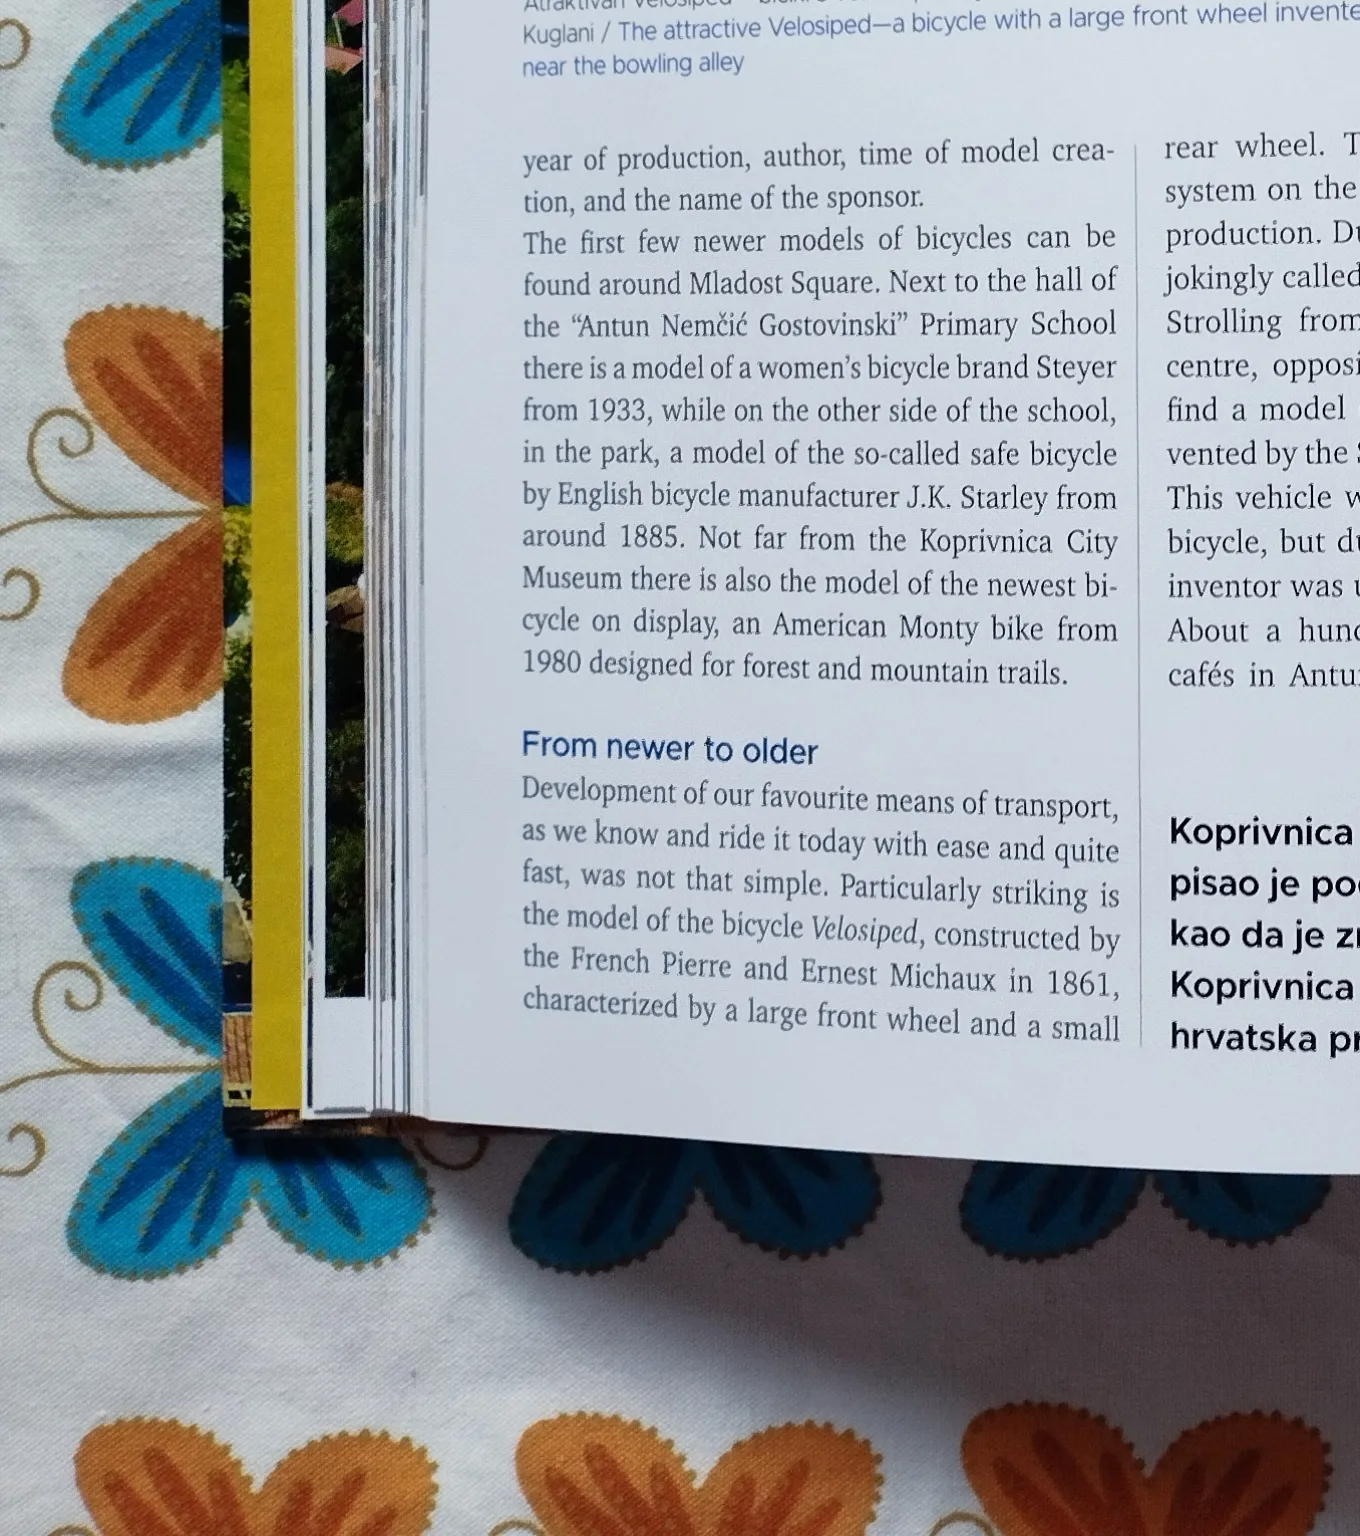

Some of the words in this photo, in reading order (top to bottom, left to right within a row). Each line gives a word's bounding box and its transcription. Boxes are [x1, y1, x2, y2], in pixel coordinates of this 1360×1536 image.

[523, 23, 594, 49] Kuglani
[617, 21, 658, 42] The
[663, 19, 762, 41] attractive
[911, 10, 987, 37] bicycle
[994, 7, 1042, 30] with
[1048, 11, 1062, 29] a
[1069, 6, 1125, 32] large
[1132, 3, 1188, 27] front
[1196, 1, 1267, 25] wheel
[522, 59, 567, 77] near
[573, 55, 607, 77] the
[612, 51, 693, 78] bowling
[698, 51, 745, 76] alley
[523, 312, 561, 339] the
[661, 310, 748, 338] Nemčić
[919, 310, 1019, 343] Primary
[1031, 308, 1117, 336] School
[1165, 438, 1258, 467] vented
[1264, 438, 1299, 473] by
[1304, 437, 1349, 466] the
[522, 479, 552, 512] by
[557, 479, 644, 512] English
[649, 480, 731, 513] bicycle
[738, 481, 901, 509] manufacturer
[906, 484, 952, 510] J.K.
[960, 483, 1049, 517] Starley
[1056, 483, 1118, 511] from
[522, 729, 598, 759] From
[607, 737, 696, 762] newer
[703, 735, 734, 764] to
[742, 735, 820, 766] older
[1170, 814, 1353, 853] Koprivnica
[1170, 865, 1260, 903] pisao
[1267, 866, 1301, 905] je
[523, 942, 560, 969] the
[571, 945, 651, 974] French
[661, 950, 732, 979] Pierre
[743, 954, 789, 982] and
[801, 957, 878, 986] Ernest
[890, 962, 997, 993] Michaux
[1009, 966, 1034, 995] in
[1047, 969, 1120, 1002] 1861,
[1170, 1020, 1318, 1053] hrvatska
